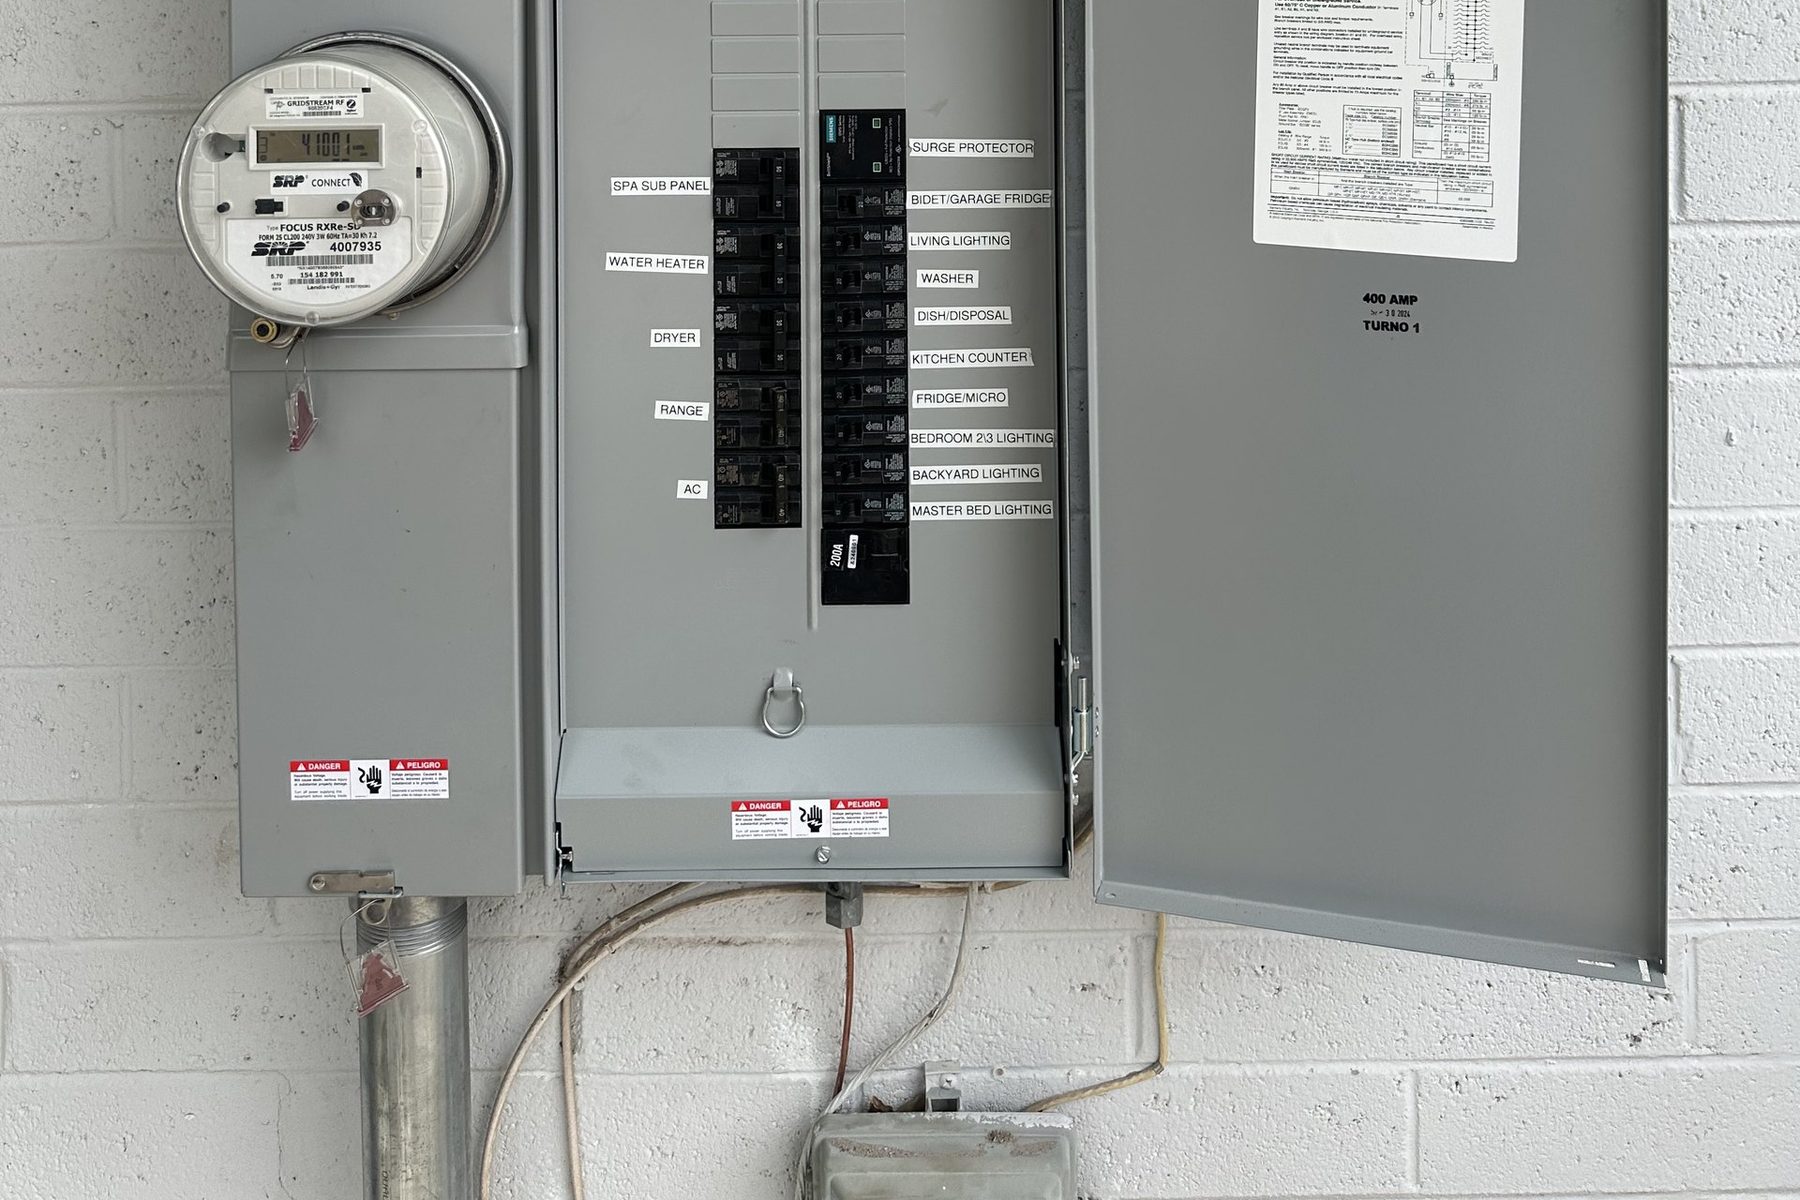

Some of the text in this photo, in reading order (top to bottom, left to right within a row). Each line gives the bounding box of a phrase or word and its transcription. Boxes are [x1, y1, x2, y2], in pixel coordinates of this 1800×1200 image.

[287, 99, 334, 107] GRIDSTREAM
[302, 132, 350, 156] 41001
[912, 142, 1035, 154] SURGE PROTECTOR
[273, 175, 351, 188] SRP CONNECT
[613, 181, 709, 191] SPA SUB PANEL
[911, 193, 1050, 205] BIDET/GARAGE FRIDGE
[280, 223, 314, 232] FOCUS
[910, 235, 1010, 246] LIVING LIGHTING
[251, 241, 382, 256] SRP 4007935
[609, 256, 705, 269] WATER HEATER
[921, 273, 974, 284] WASHER
[1362, 293, 1418, 305] 400 AMP
[917, 310, 1009, 321] DISH/DISPOSAL
[1363, 320, 1420, 333] TURNO 1
[654, 333, 696, 343] DRYER
[912, 352, 1028, 364] KITCHEN COUNTER
[916, 392, 1006, 404] FRIDGE/MICRO
[660, 405, 703, 416] RANGE
[911, 433, 1054, 444] BEDROOM 2\3 LIGHTING
[912, 468, 1040, 480] BACKYARD LIGHTING
[684, 484, 701, 494] AC
[912, 504, 1052, 516] MASTER BED LIGHTING
[830, 543, 844, 567] 200A
[407, 761, 441, 769] PELIGRO
[847, 800, 881, 808] PELIGRO
